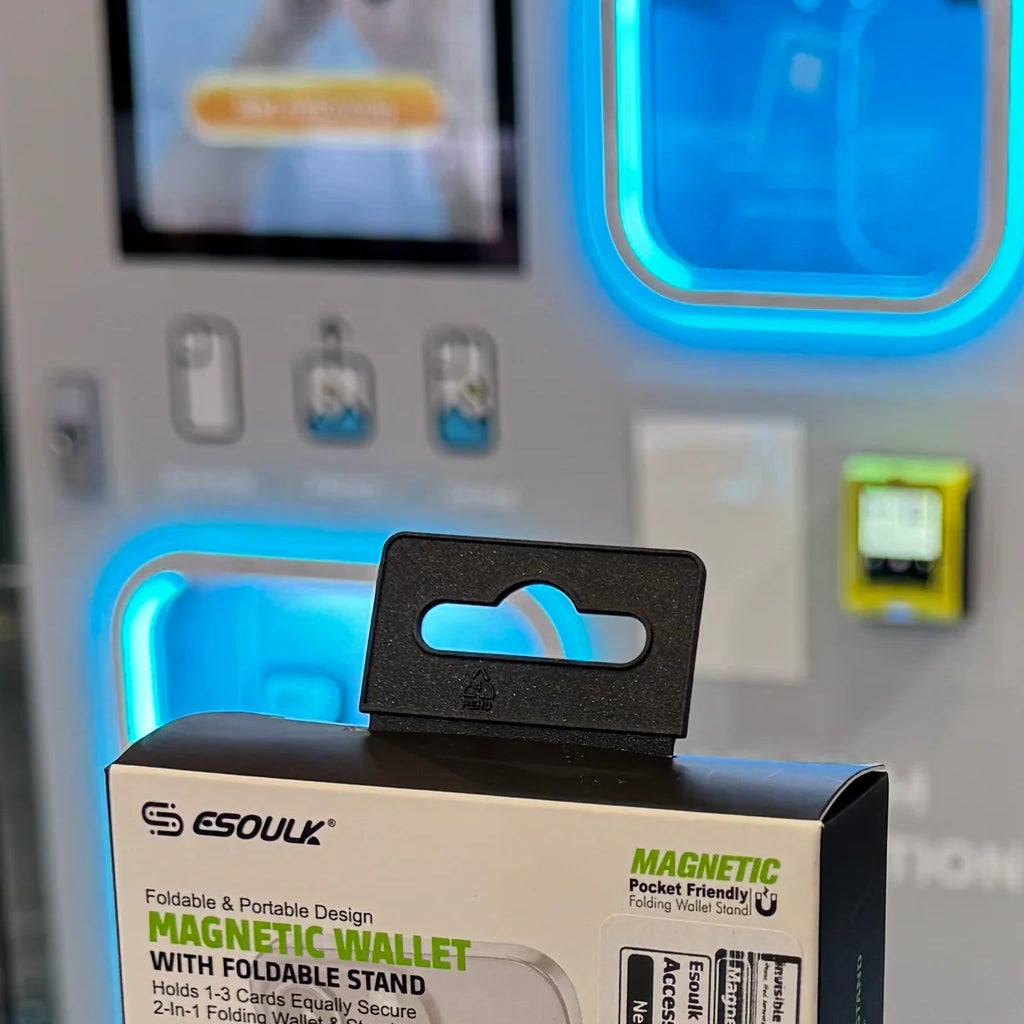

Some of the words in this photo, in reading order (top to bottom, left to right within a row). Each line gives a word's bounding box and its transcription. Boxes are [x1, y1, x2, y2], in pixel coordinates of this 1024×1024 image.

[630, 847, 781, 885] MAGNETIC
[145, 889, 216, 910] Foldable
[222, 896, 234, 911] &
[239, 898, 309, 918] Portable
[315, 905, 373, 926] Design
[629, 878, 682, 897] Pocket
[687, 883, 749, 904] Friendly
[629, 895, 672, 913] Folding
[675, 898, 712, 913] Wallet
[716, 901, 749, 916] Stand
[148, 910, 325, 959] MAGNETIC
[334, 928, 472, 971] WALLET
[150, 951, 213, 976] WITH
[223, 957, 340, 988] FOLDABLE
[347, 970, 426, 996] STAND
[688, 960, 704, 1020] Esoulk
[152, 980, 199, 999] Holds
[205, 986, 231, 1002] 1-3
[236, 988, 286, 1007] Cards
[291, 994, 351, 1016] Equally
[357, 1000, 417, 1019] Secure
[153, 1000, 200, 1019] 2-In-1
